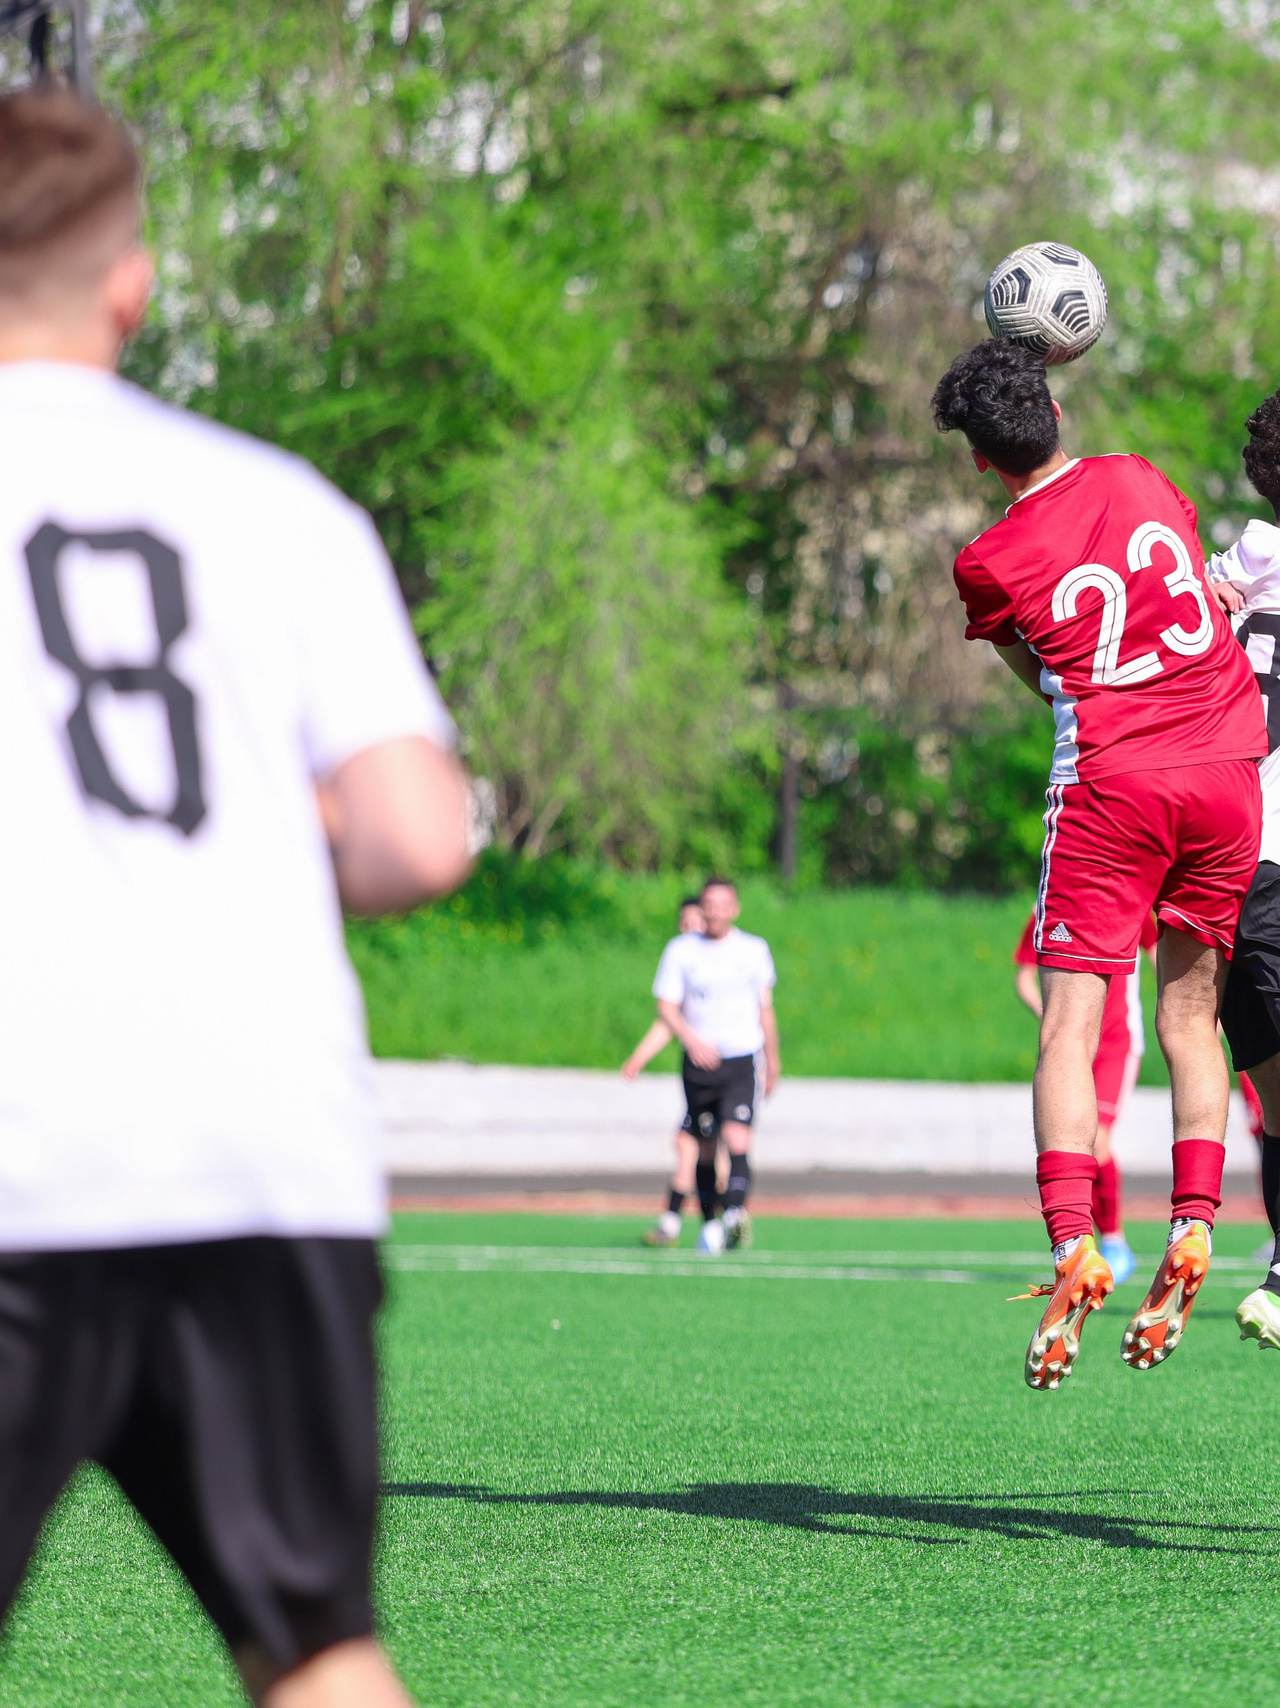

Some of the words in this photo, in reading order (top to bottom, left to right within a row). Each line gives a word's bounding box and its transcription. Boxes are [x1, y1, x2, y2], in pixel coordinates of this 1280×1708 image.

[24, 521, 206, 836] 8
[1051, 521, 1215, 686] 23
[1048, 933, 1073, 943] adidas
